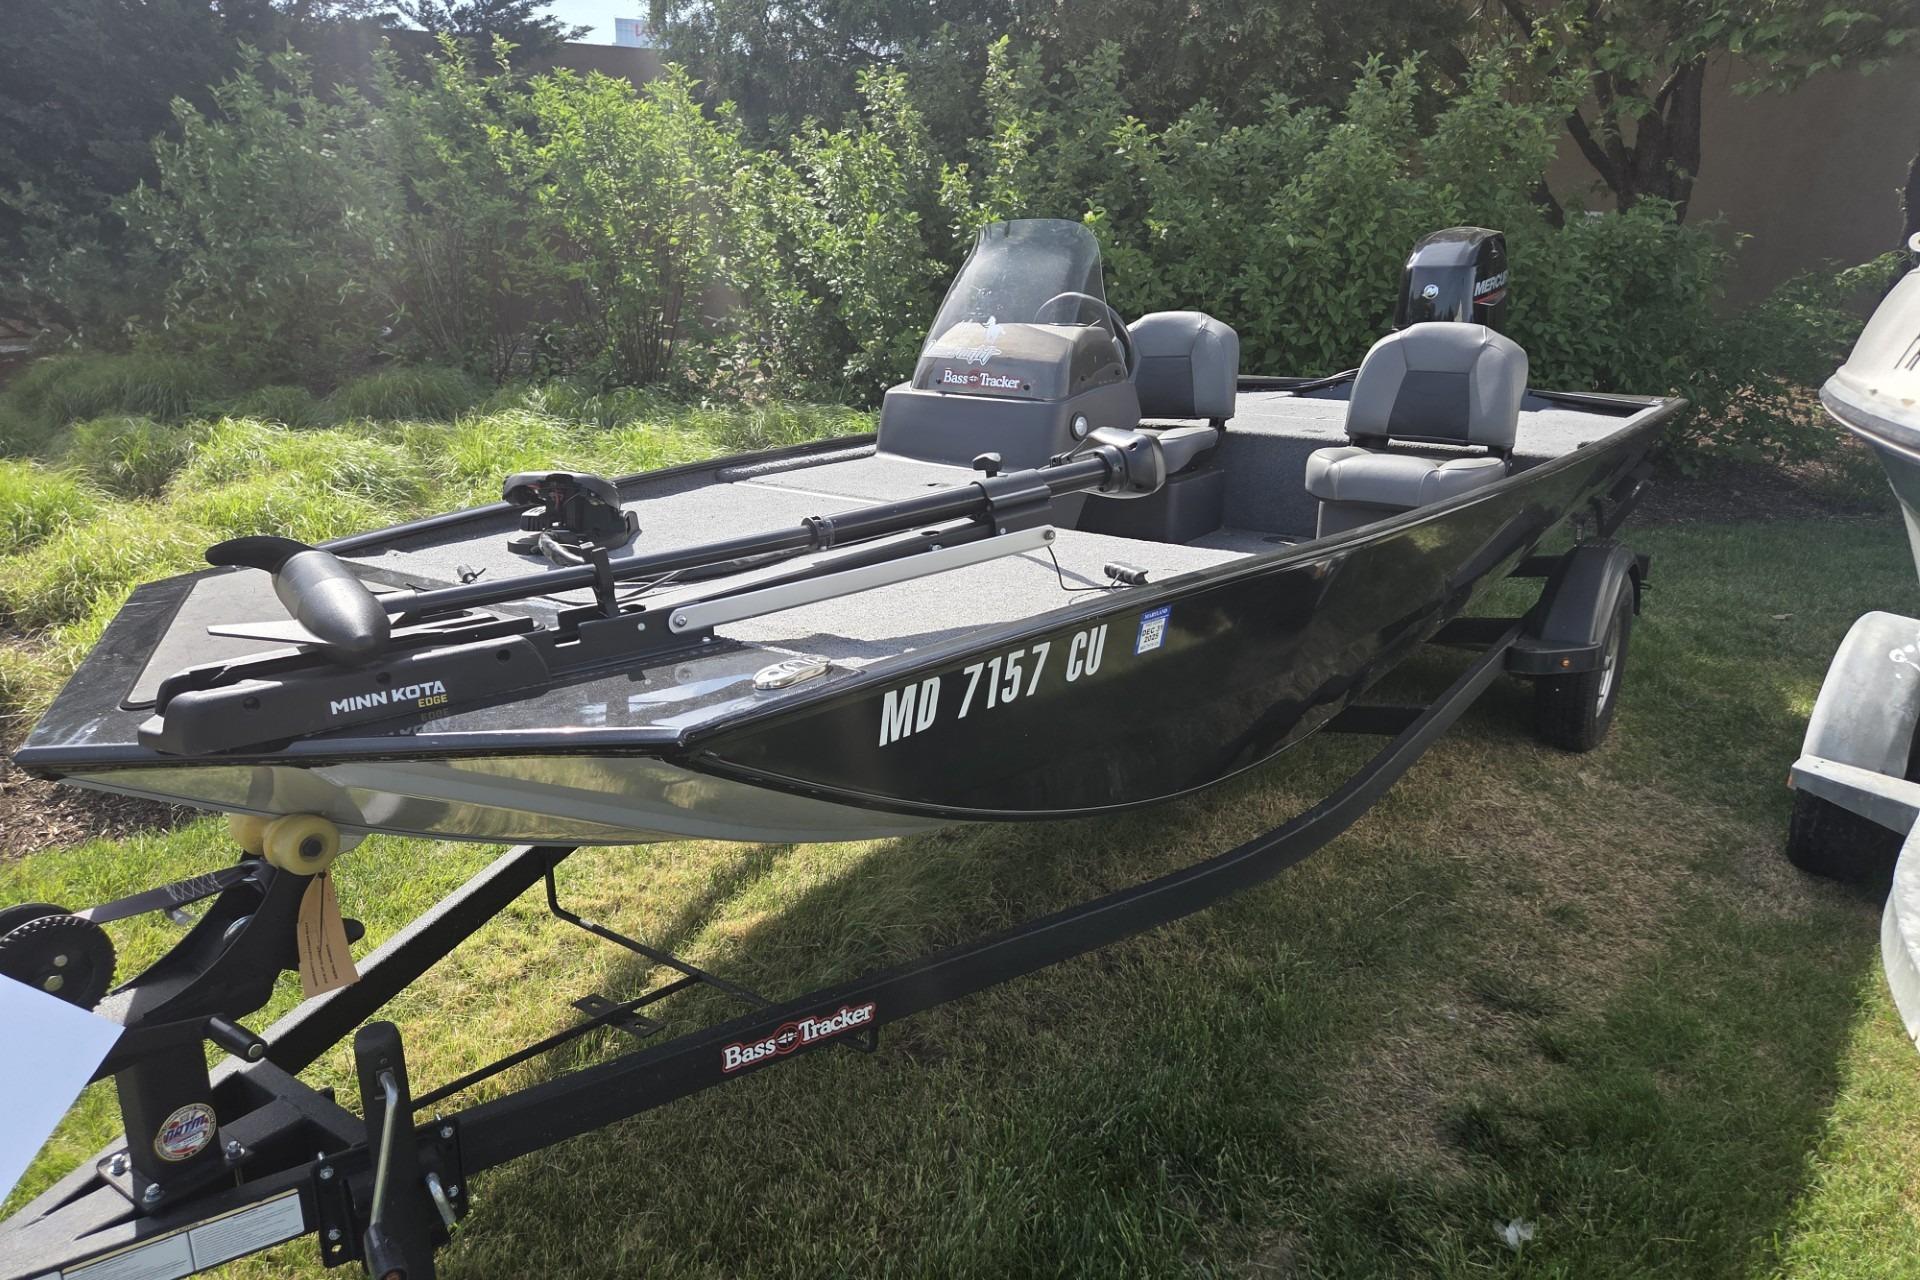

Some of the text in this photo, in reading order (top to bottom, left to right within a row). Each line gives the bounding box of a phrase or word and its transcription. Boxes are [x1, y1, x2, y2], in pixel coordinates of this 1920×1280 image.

[943, 369, 1020, 388] Bass Tracker
[330, 680, 446, 715] MINN KOTA
[418, 694, 448, 708] EDGE
[879, 623, 1108, 748] MD 7157 CU
[724, 1005, 873, 1070] Bass Tracker
